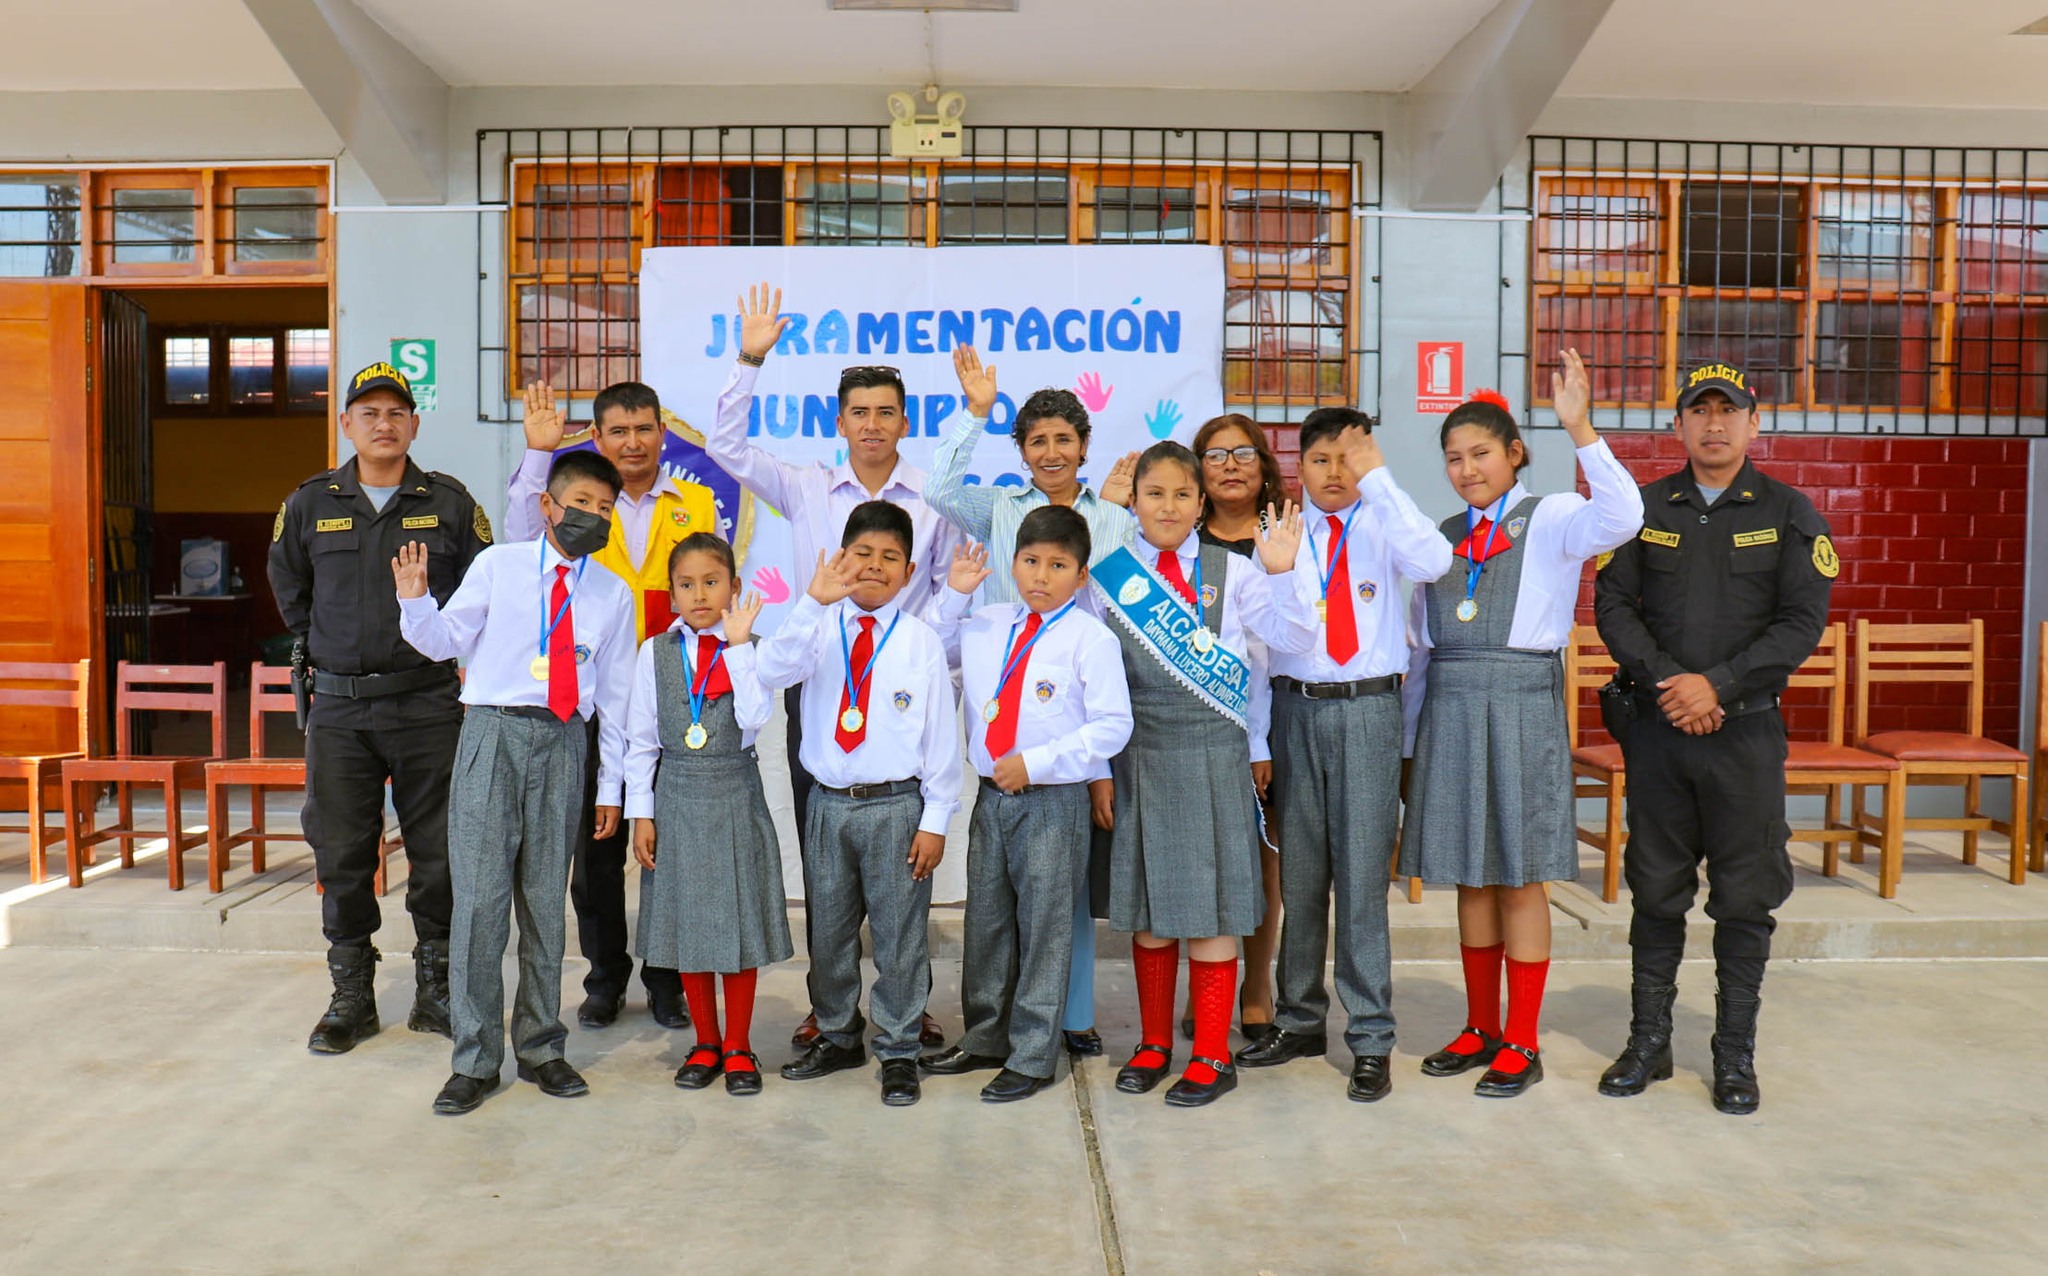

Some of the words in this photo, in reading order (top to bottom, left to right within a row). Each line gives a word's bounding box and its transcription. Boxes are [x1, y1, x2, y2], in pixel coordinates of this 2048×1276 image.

[705, 297, 1181, 359] JRAMENTACIÓN
[399, 342, 429, 381] S
[1688, 364, 1745, 390] POLICIA
[747, 391, 1017, 440] UNIPO
[1175, 651, 1211, 685] LUCERO
